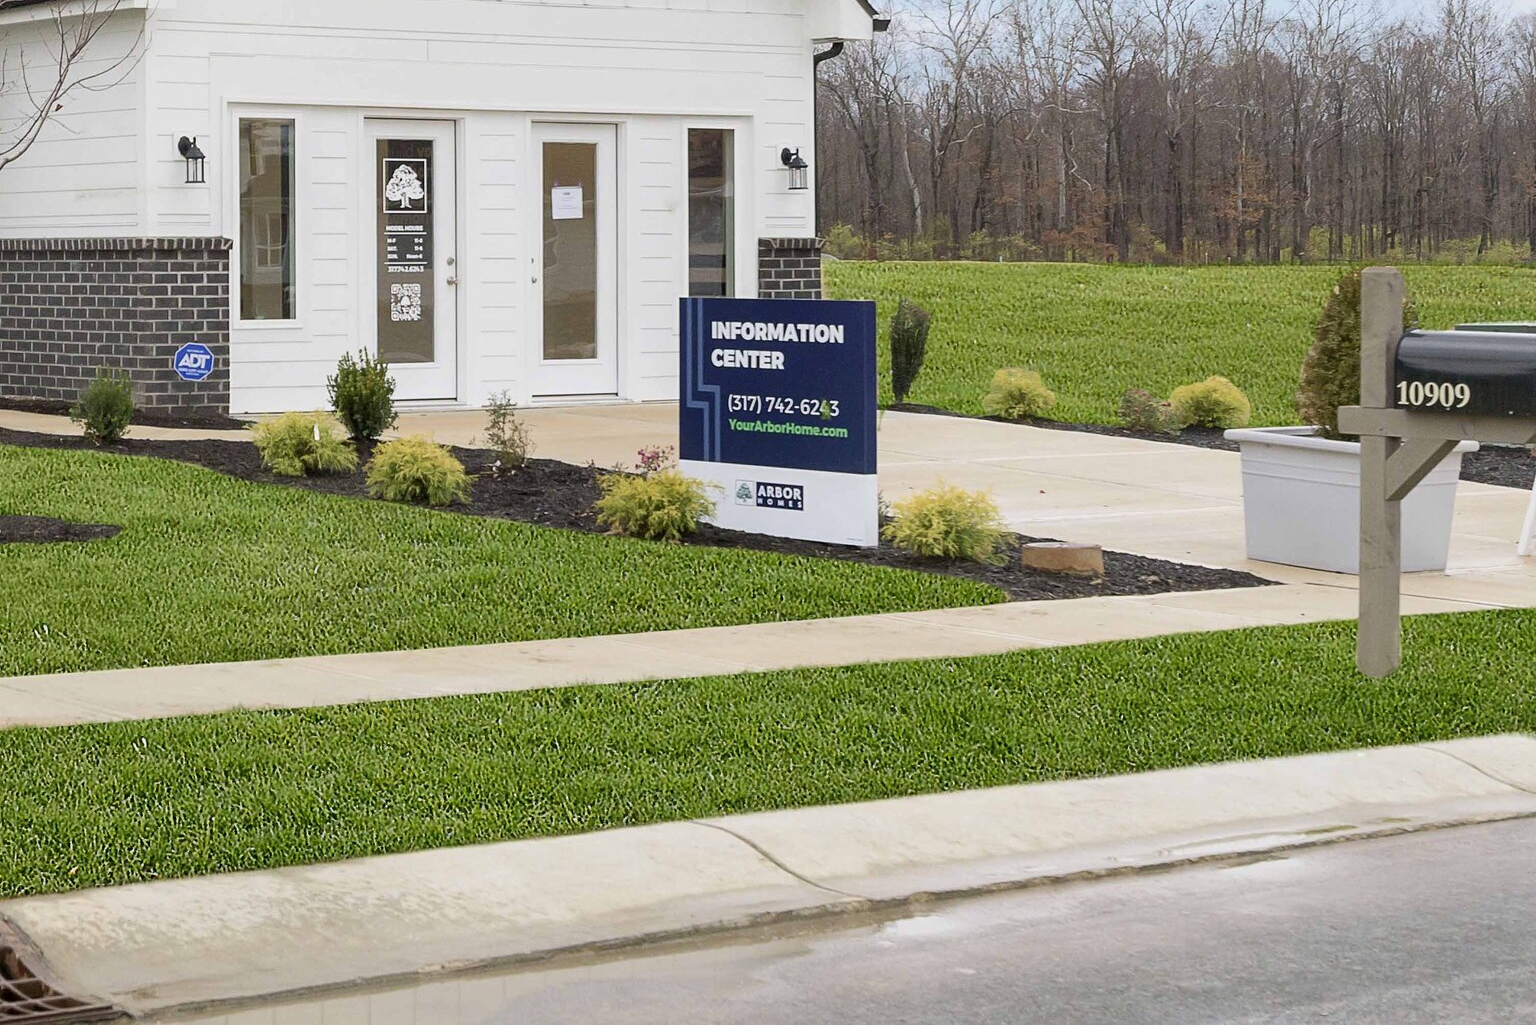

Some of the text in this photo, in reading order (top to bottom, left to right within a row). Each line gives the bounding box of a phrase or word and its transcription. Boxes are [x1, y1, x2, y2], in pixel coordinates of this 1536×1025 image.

[711, 321, 844, 344] INFORMATION
[178, 353, 211, 369] ADT
[710, 348, 785, 370] CENTER
[1396, 380, 1471, 408] 10909
[727, 393, 840, 417] (317) 742-6243
[728, 418, 848, 438] YourArborHome.com
[757, 484, 802, 500] ARBOR
[757, 498, 803, 509] HOMES
